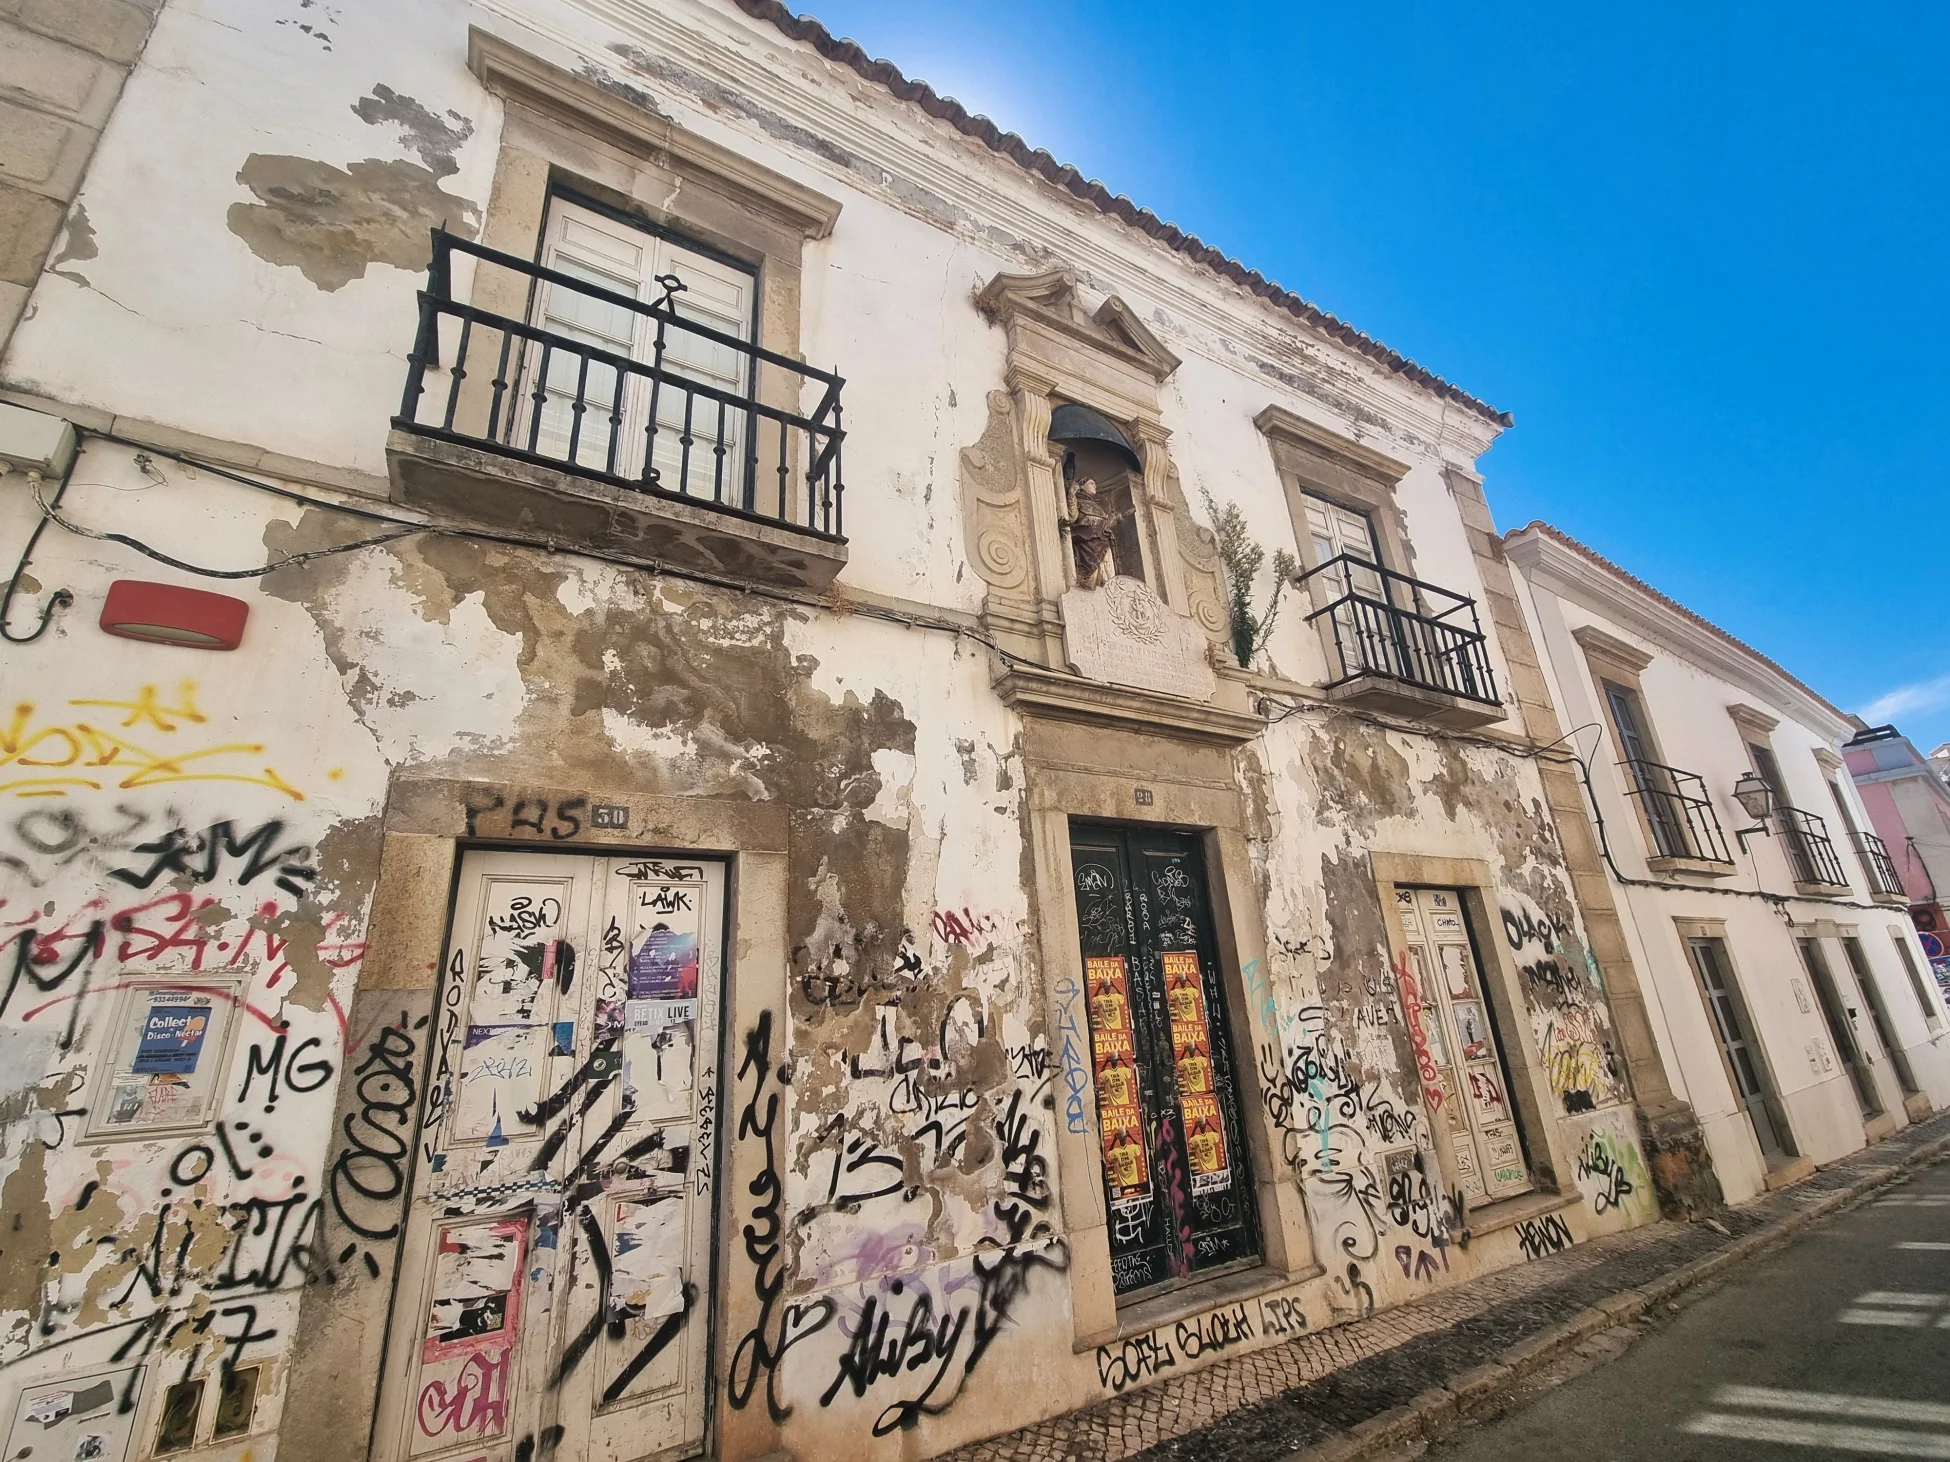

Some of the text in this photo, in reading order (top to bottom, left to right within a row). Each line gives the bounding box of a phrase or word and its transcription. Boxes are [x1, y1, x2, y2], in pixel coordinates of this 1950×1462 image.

[1087, 960, 1109, 968] BAILE
[1164, 956, 1184, 964] BAILE
[1088, 968, 1122, 979] BAIXA
[1165, 964, 1197, 974] BAIXA
[668, 1005, 689, 1019] LIVE
[150, 1015, 192, 1029] Collect
[1172, 1024, 1193, 1033] BAILE
[147, 1030, 203, 1040] Disco Nectar
[1094, 1033, 1117, 1042] BAILE
[1173, 1032, 1206, 1044] BAIXA
[1095, 1040, 1131, 1054] BAIXA
[1182, 1098, 1204, 1108] BAILE
[1101, 1108, 1125, 1119] BAILE
[1184, 1106, 1217, 1120] BAIXA
[1103, 1116, 1139, 1132] BAIXA
[1258, 1296, 1308, 1336] LIPS
